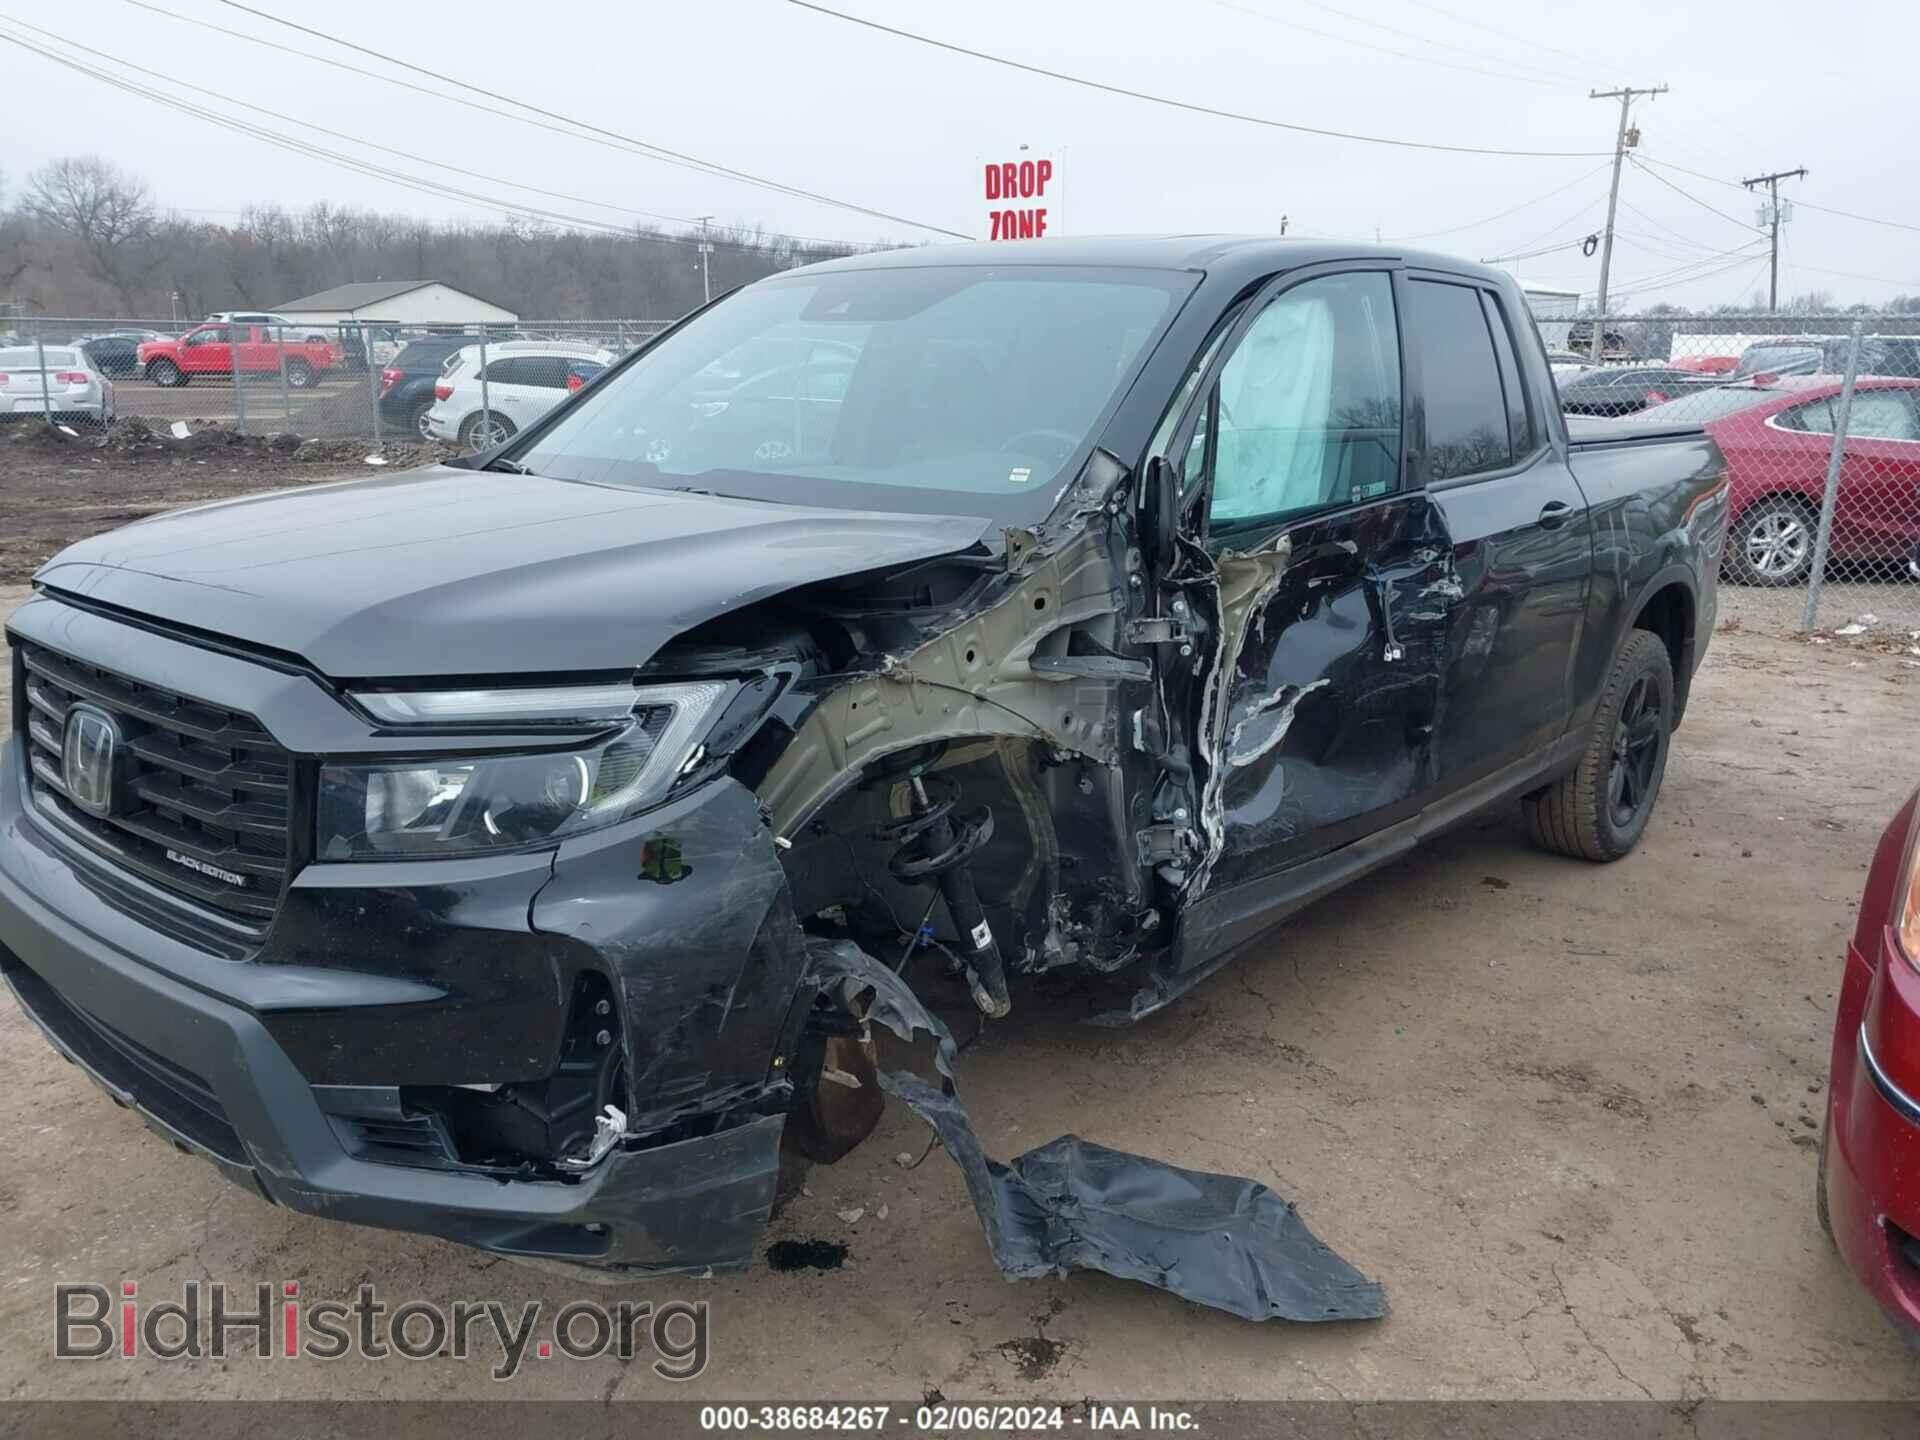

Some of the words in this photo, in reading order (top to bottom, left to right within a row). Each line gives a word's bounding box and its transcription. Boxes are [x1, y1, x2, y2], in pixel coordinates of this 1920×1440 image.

[985, 160, 1052, 200] DROP
[166, 849, 201, 871] BLACK
[201, 863, 247, 887] EDITION
